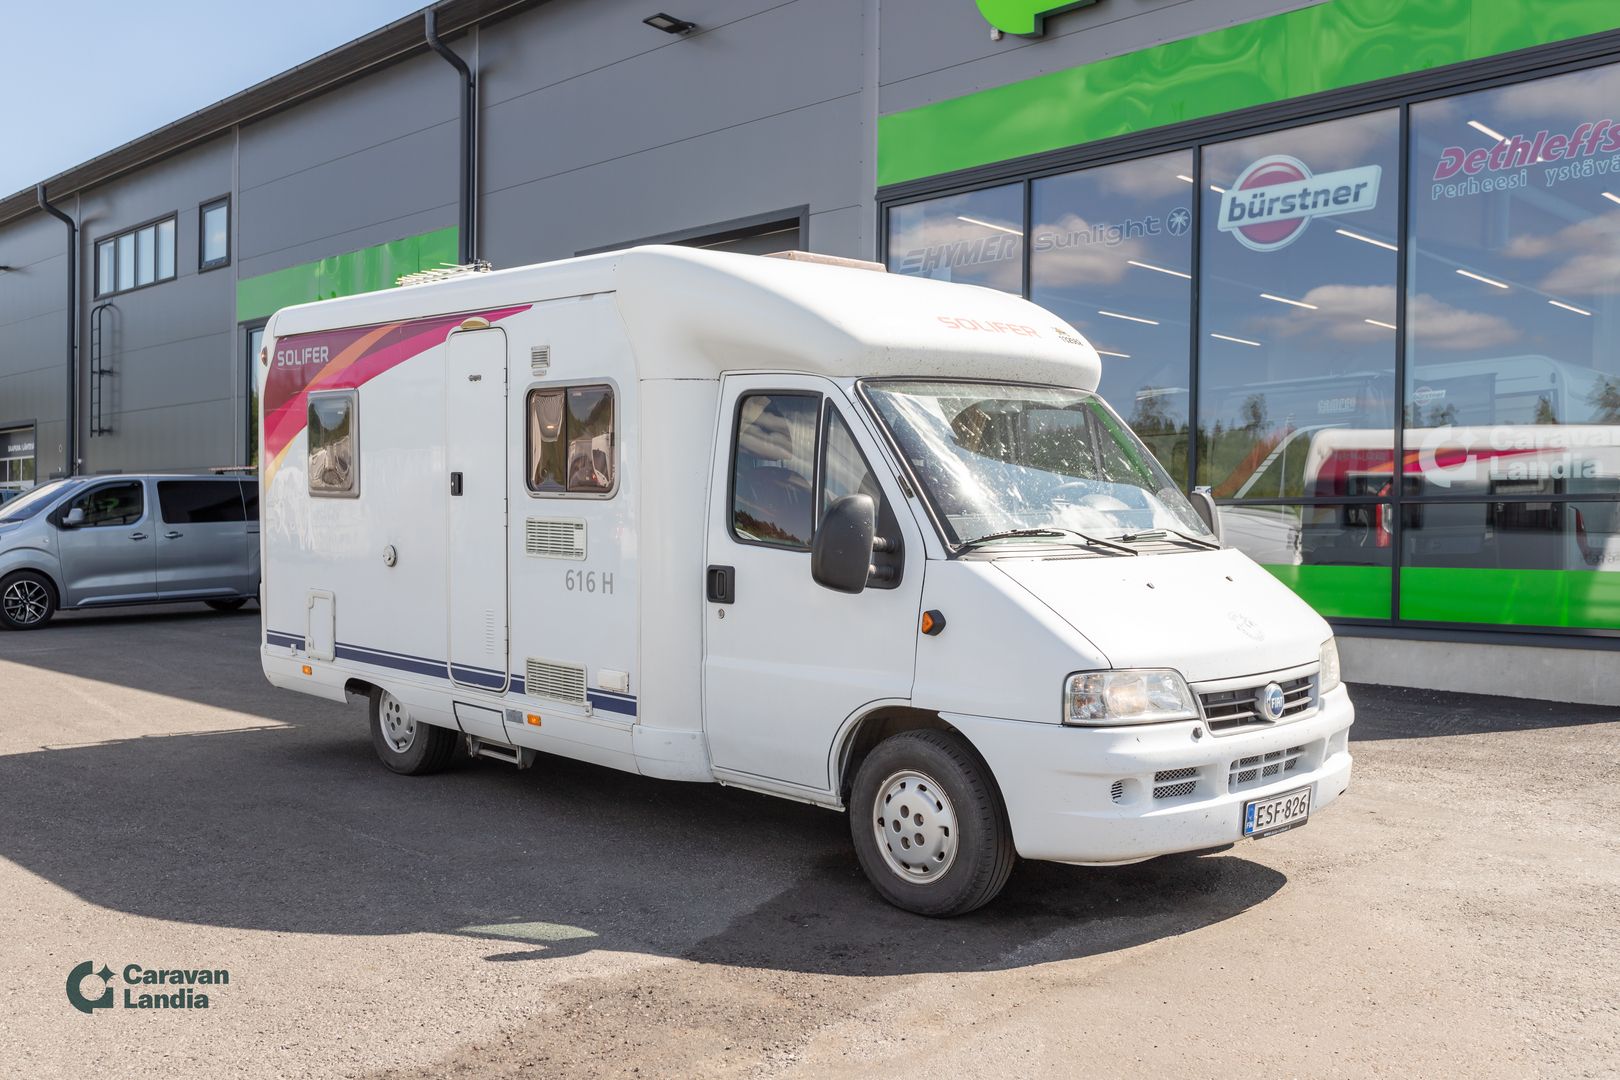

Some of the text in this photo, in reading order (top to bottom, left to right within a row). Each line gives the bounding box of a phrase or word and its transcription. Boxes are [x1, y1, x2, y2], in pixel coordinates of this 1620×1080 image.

[1433, 119, 1620, 181] Dethleffs
[1431, 169, 1528, 200] Perheesi
[1228, 181, 1369, 223] bürstner
[920, 232, 1018, 274] HYMER
[937, 316, 1042, 338] SOLIFER
[277, 345, 329, 367] SOLIFER
[1489, 452, 1604, 481] Landia
[565, 569, 613, 595] 616 H
[1255, 794, 1307, 827] ESF-826
